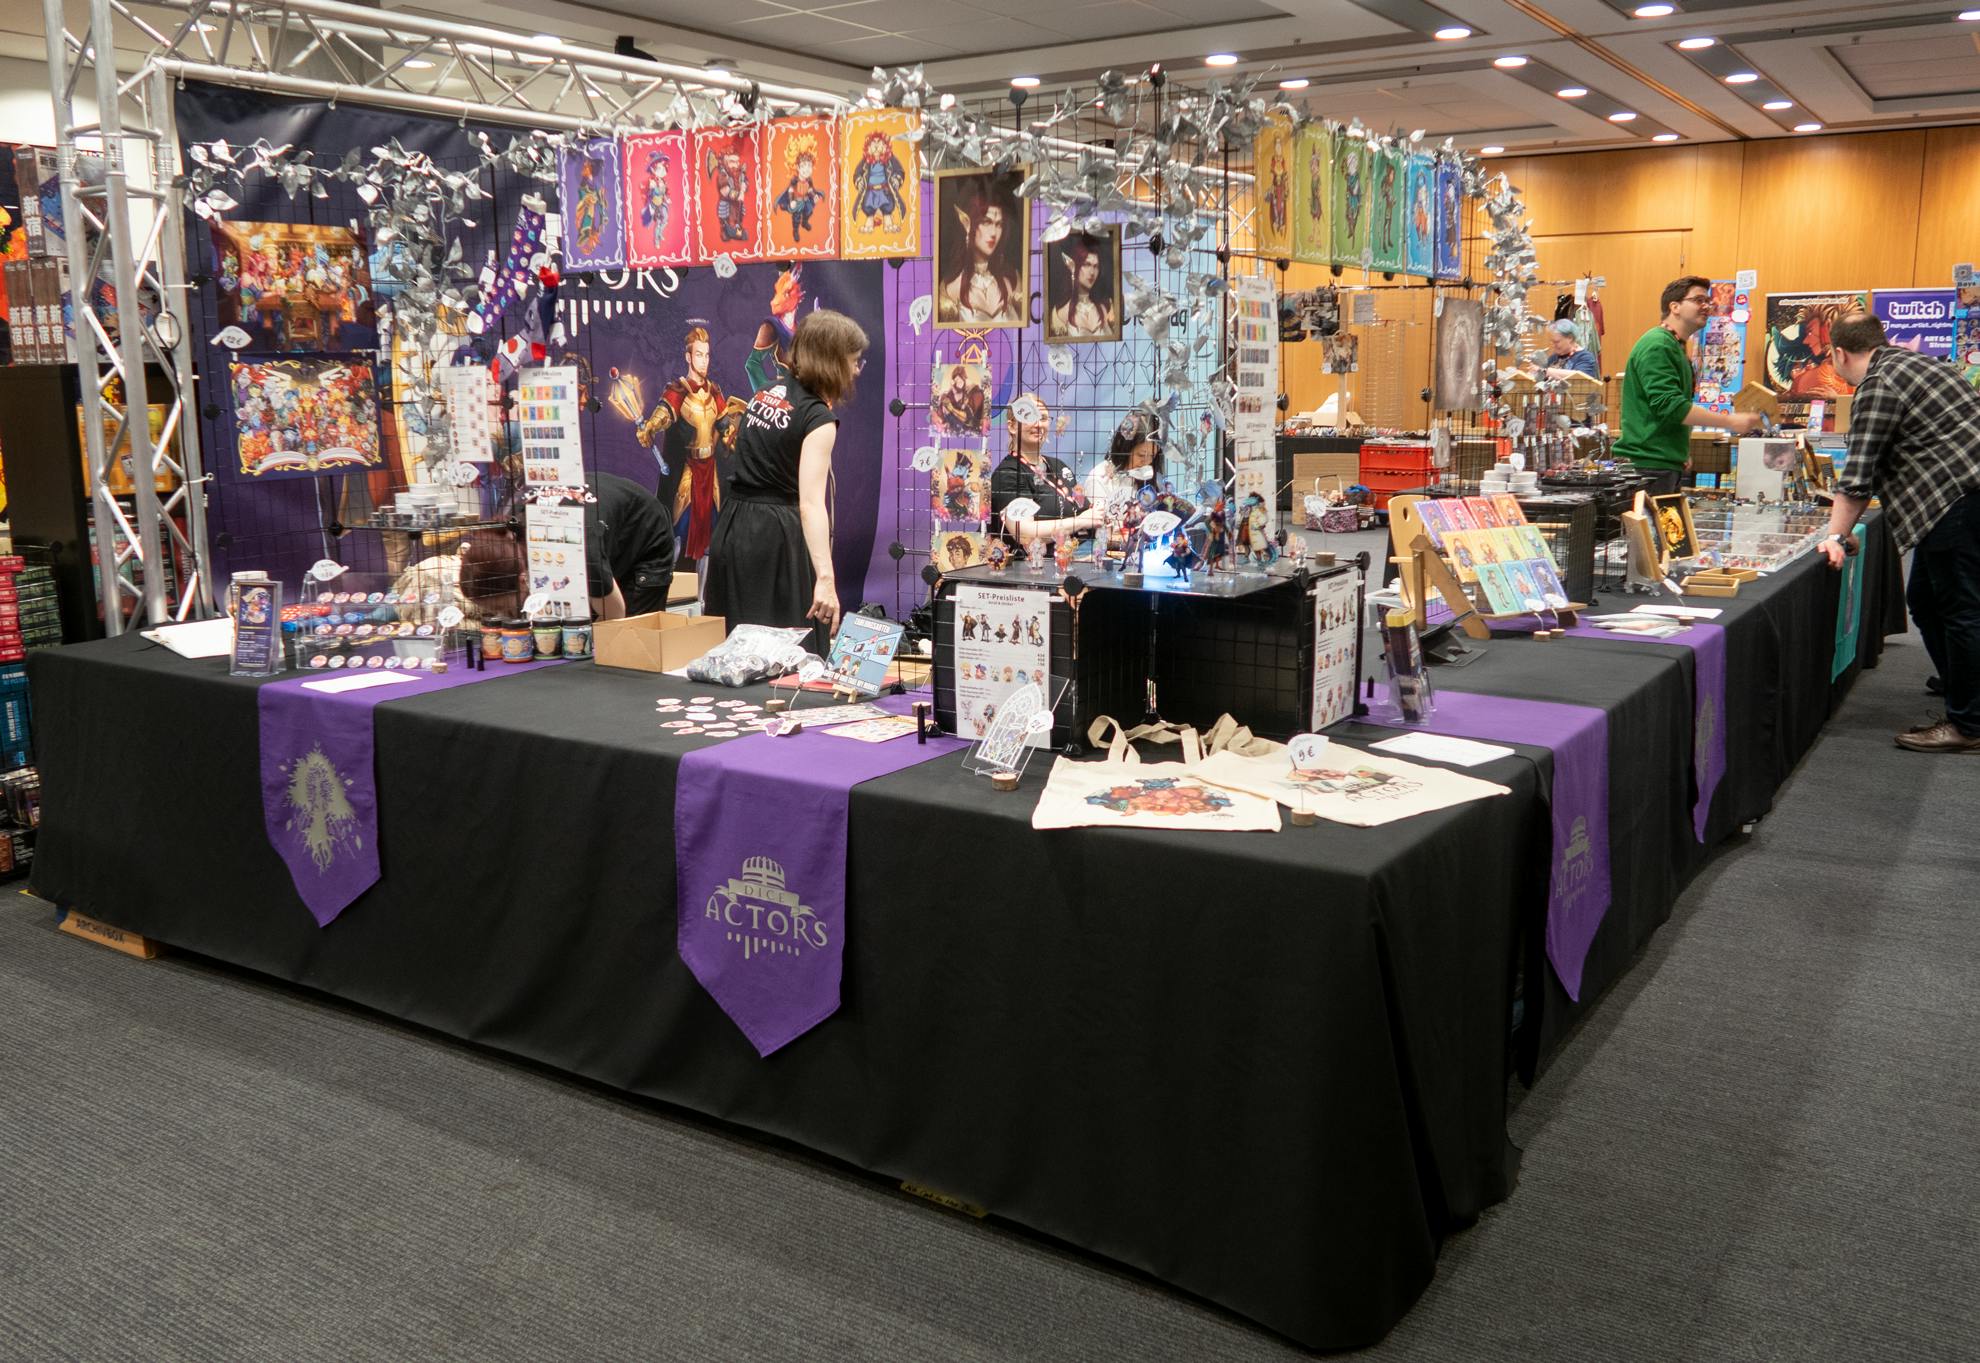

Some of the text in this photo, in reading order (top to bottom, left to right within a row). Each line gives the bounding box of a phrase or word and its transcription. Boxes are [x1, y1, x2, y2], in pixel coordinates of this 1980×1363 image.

[23, 195, 42, 237] 新宿
[1889, 301, 1946, 319] twitch
[978, 592, 1025, 603] SET-Preisliste
[744, 885, 786, 903] DICE
[705, 895, 828, 950] ACTORS
